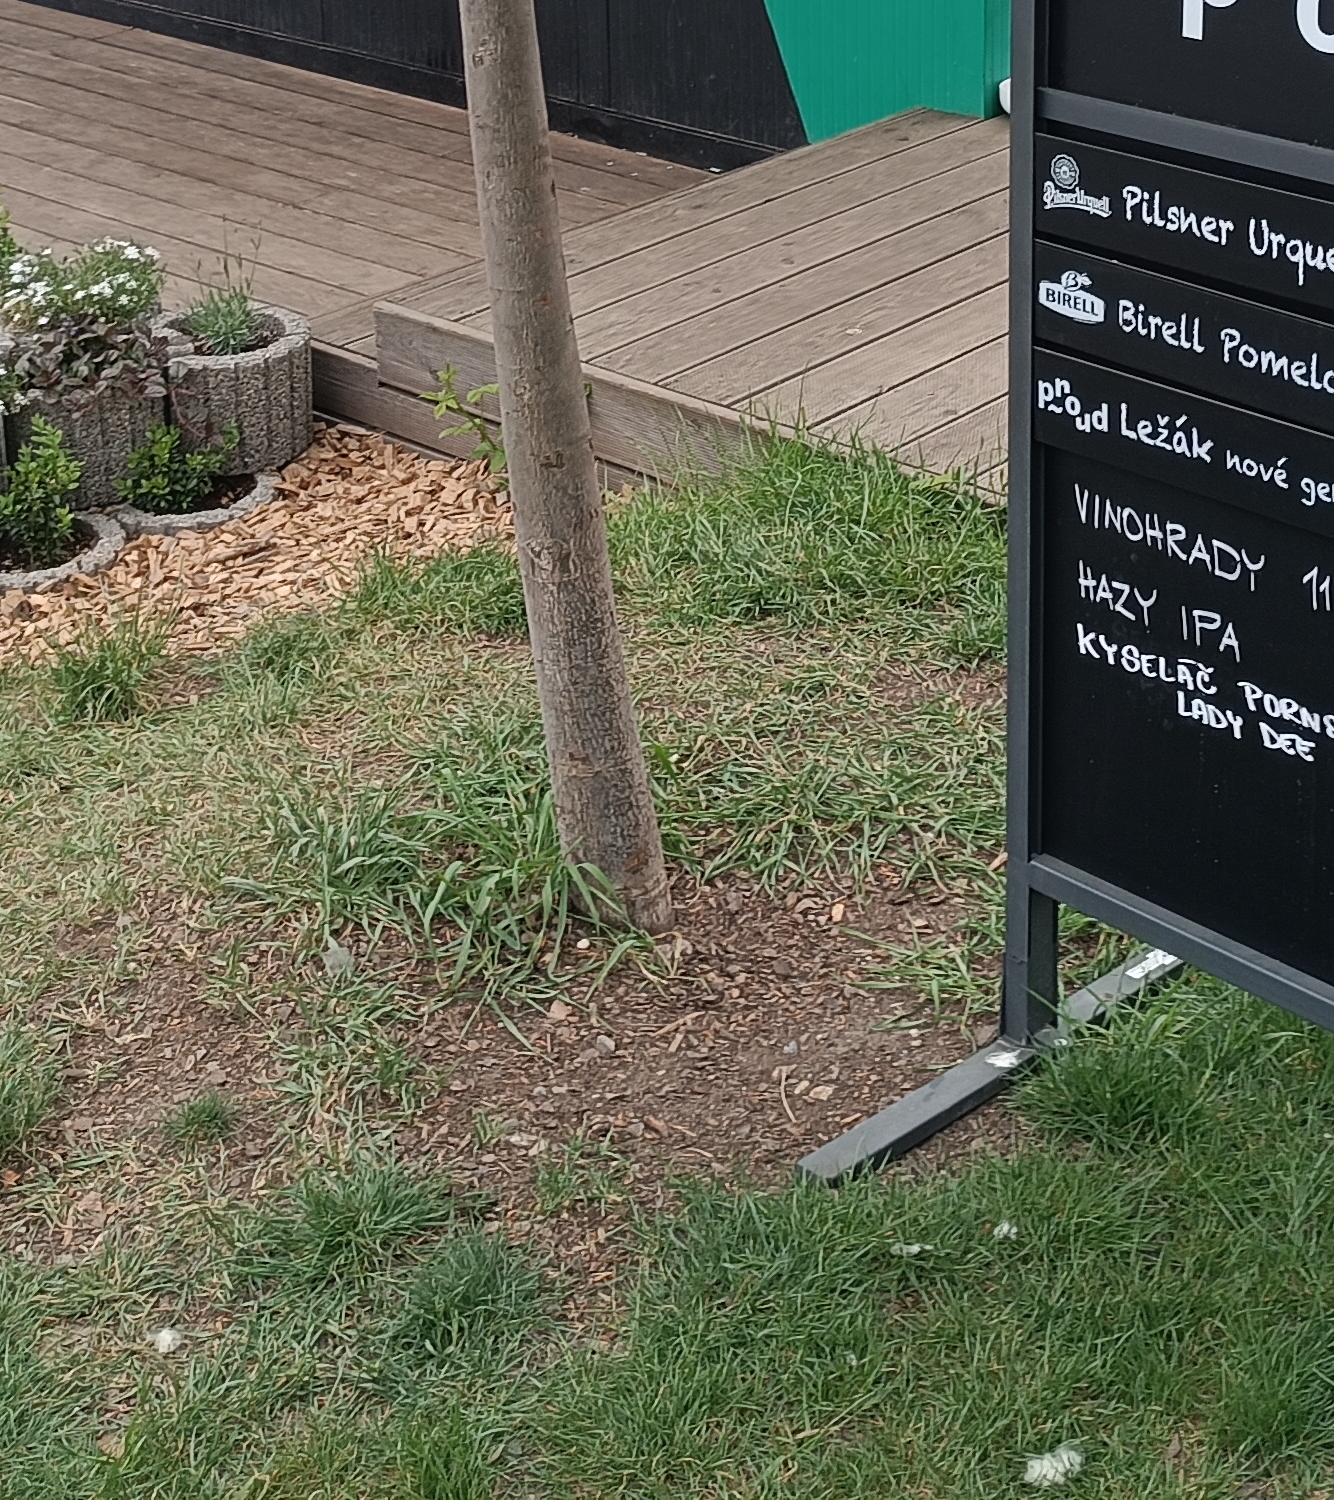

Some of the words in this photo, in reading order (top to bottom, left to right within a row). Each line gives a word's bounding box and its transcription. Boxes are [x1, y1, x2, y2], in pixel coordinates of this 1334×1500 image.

[1121, 184, 1235, 247] Pilsner
[1044, 286, 1099, 317] BIRELL
[1118, 298, 1205, 354] Birell
[1037, 377, 1109, 433] proud
[1119, 401, 1213, 464] Ležák
[1225, 448, 1290, 491] nové
[1074, 483, 1266, 593] VINOHRADY
[1077, 560, 1157, 635] HAZY
[1180, 605, 1243, 663] IPA
[1176, 691, 1244, 741] LADY
[1259, 722, 1316, 764] DEE
